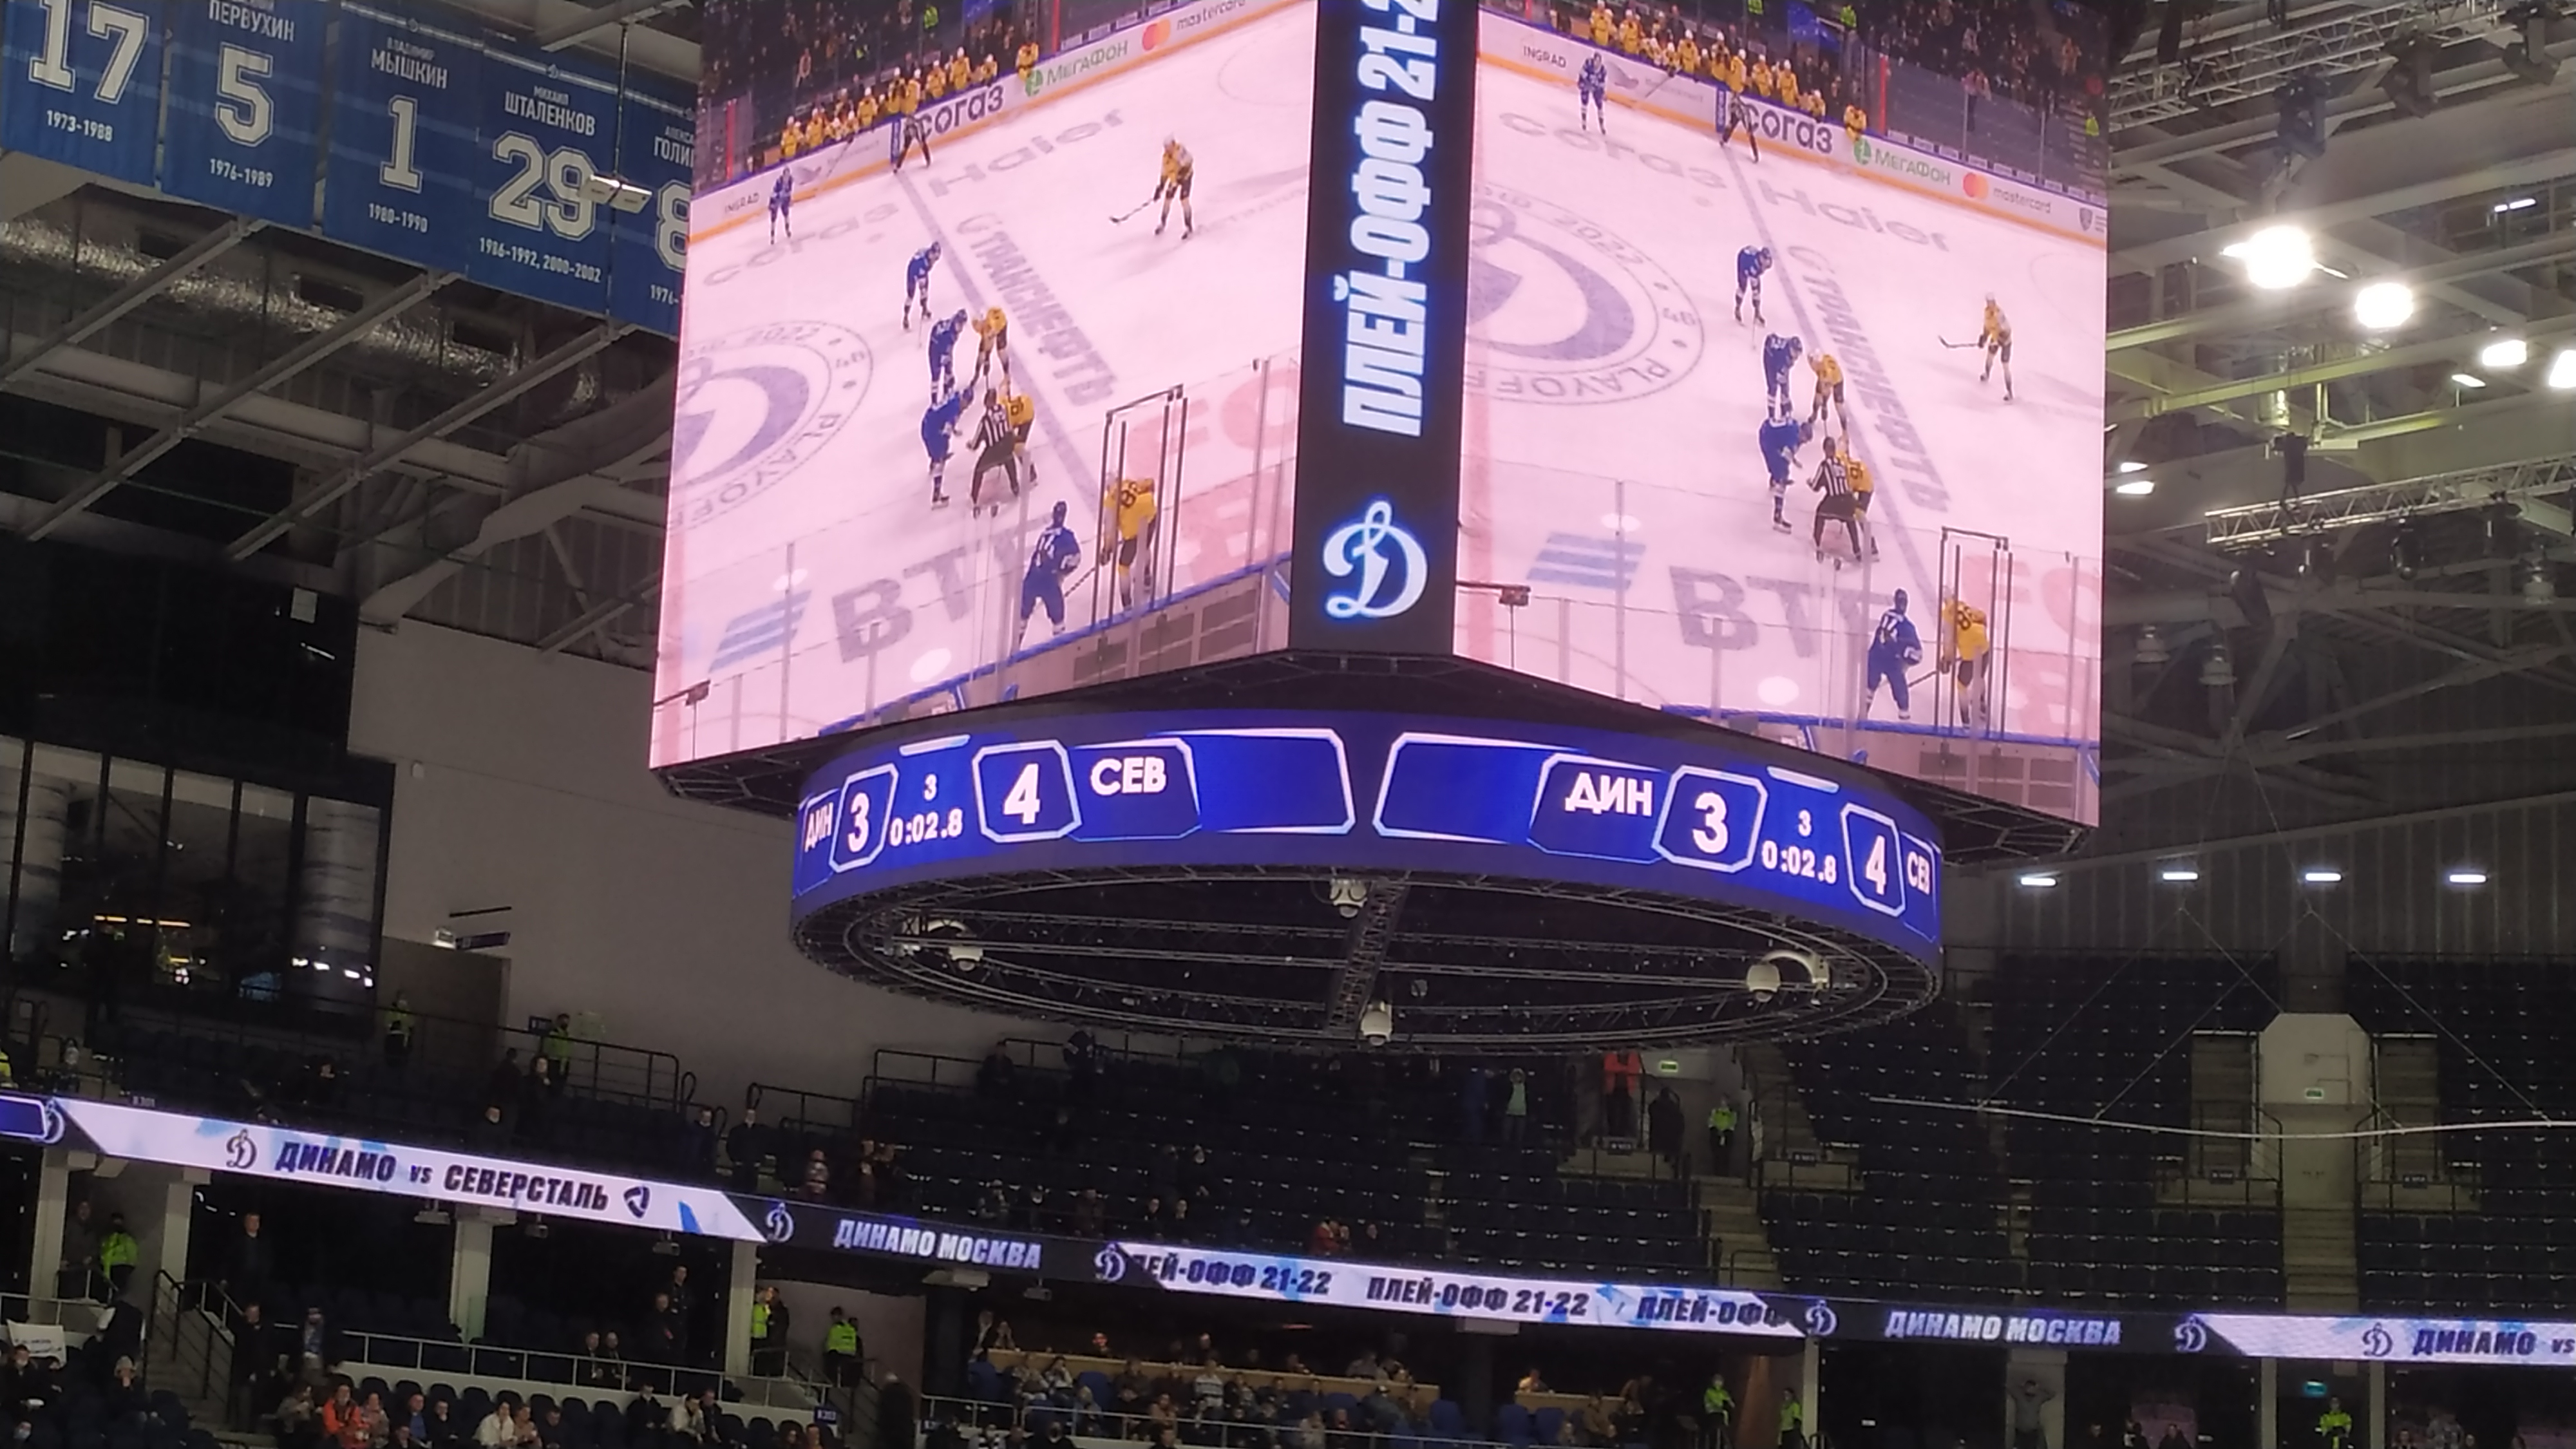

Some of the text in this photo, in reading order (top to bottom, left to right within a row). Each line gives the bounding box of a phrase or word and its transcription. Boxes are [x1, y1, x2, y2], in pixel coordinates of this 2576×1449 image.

[209, 0, 294, 42] ПЕРВУХИН
[29, 0, 149, 105] 17
[371, 48, 448, 90] МЫШКИН
[1522, 45, 1567, 69] INGRAD
[215, 42, 274, 147] 5
[504, 91, 596, 136] ШТАЛЕНКОВ
[46, 109, 113, 142] 1973-1988
[379, 94, 422, 193] 1
[209, 158, 274, 188] 1976-1989
[488, 130, 599, 242] 29
[1756, 178, 1950, 253] Haier
[1992, 185, 2051, 214] mastercard
[1333, 100, 1434, 437] ПЛЕЙ-ОФФ
[923, 774, 938, 801] 3
[1003, 762, 1041, 824] 4
[1090, 756, 1167, 796] СЕВ
[1564, 772, 1653, 817] ДИН
[804, 802, 833, 852] ДИН
[847, 792, 869, 853] 3
[889, 808, 963, 846] 0:02.8
[1692, 791, 1729, 854] 3
[1798, 810, 1812, 837] 3
[1761, 838, 1837, 884] 0:02.8
[1866, 835, 1887, 896] 4
[274, 1142, 397, 1183] ДИНАМО
[443, 1163, 609, 1211] СЕВЕРСТАЛЬ
[833, 1219, 1042, 1269] ДИНАМО МОСКВА
[1260, 1265, 1332, 1296] 21-22
[1366, 1273, 1590, 1317] ПЛЕЙ-ОФФ 21-22
[1884, 1310, 2123, 1345] ДИНАМО МОСКВА
[2411, 1329, 2537, 1356] ДИНАМО
